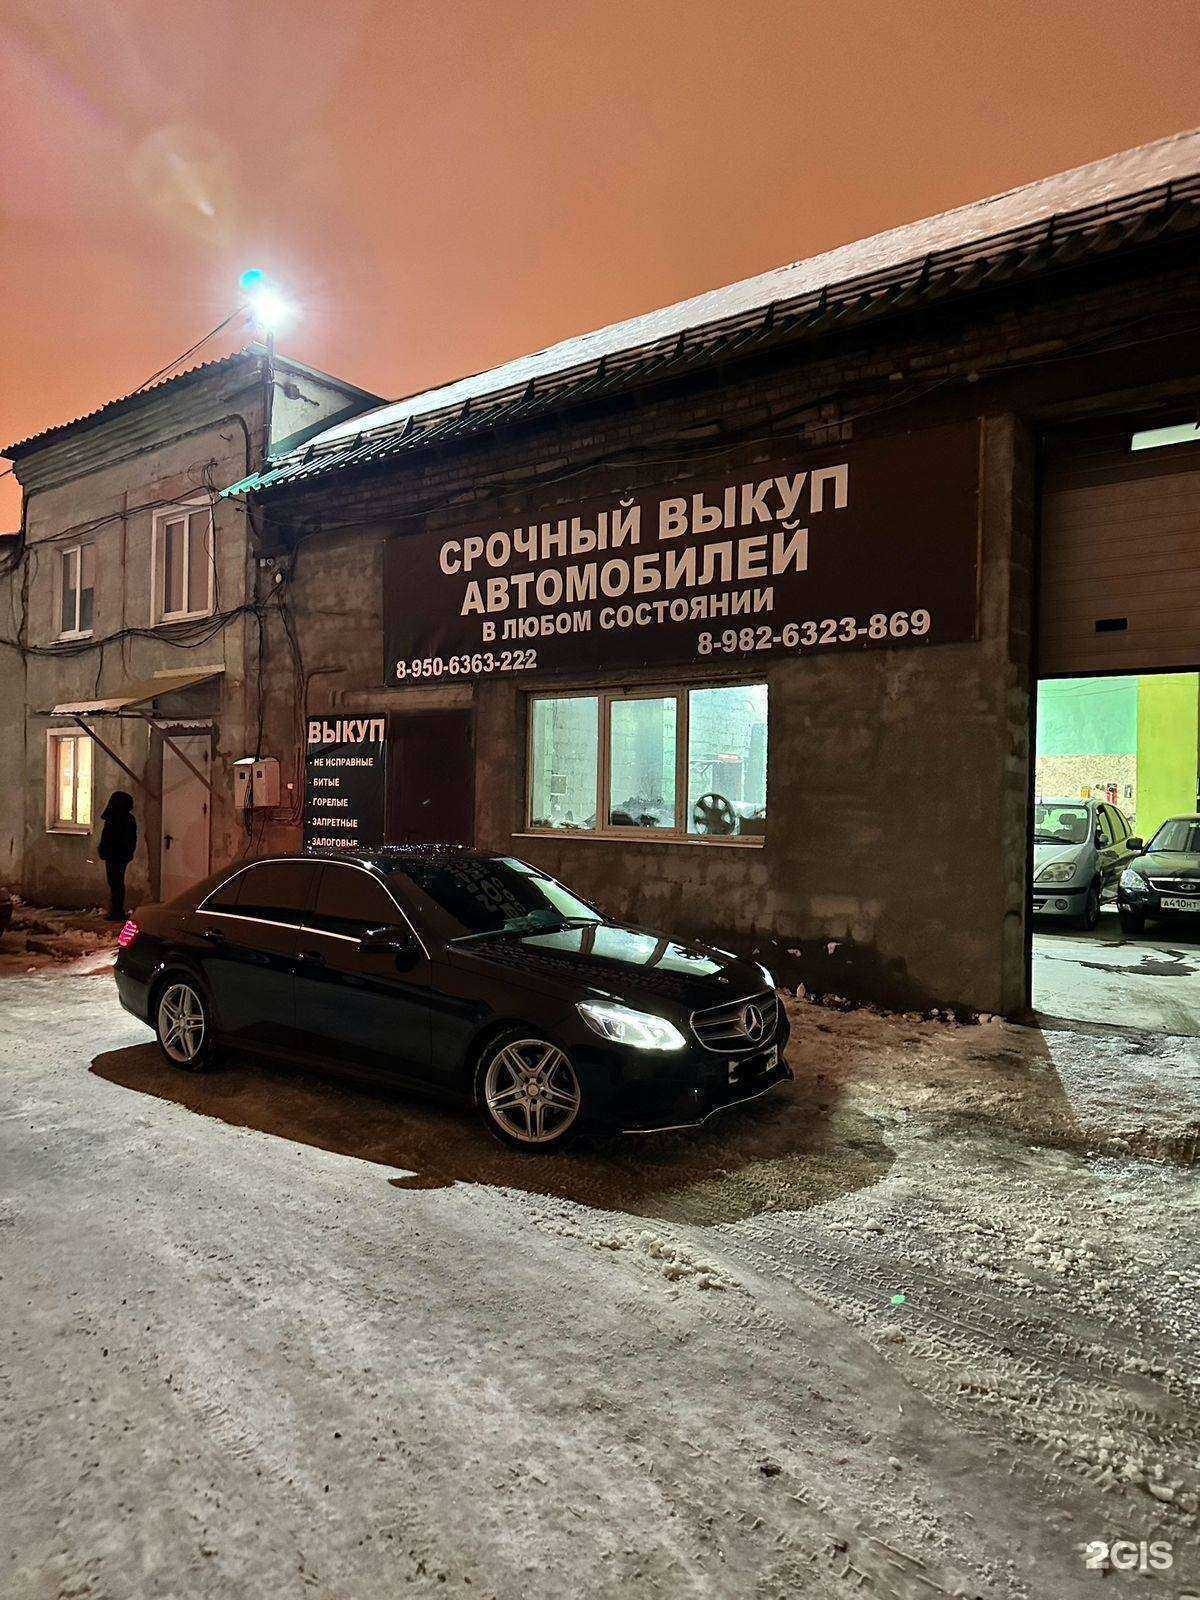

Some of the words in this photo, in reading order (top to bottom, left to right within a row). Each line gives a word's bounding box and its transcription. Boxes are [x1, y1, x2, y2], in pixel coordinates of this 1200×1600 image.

[438, 500, 642, 576] СРОЧНЫЙ
[658, 463, 850, 542] ВЫКУП
[459, 521, 810, 617] АВТОМОБИЛЕЙ
[482, 620, 497, 643] В
[501, 610, 592, 641] ЛЮБОМ
[599, 587, 775, 631] СОСТОЯНИИ
[697, 608, 932, 656] 8-982-6323-869
[395, 648, 538, 680] 8-950-6363-222
[308, 718, 385, 743] ВЫКУП
[313, 758, 324, 767] НЕ
[325, 758, 374, 767] ИСПРАВНЫЕ
[313, 778, 340, 787] БИТЫЕ
[312, 797, 349, 807] ГОРЕЛЫЕ
[312, 818, 358, 828] ЗАПРЕТНЫЕ
